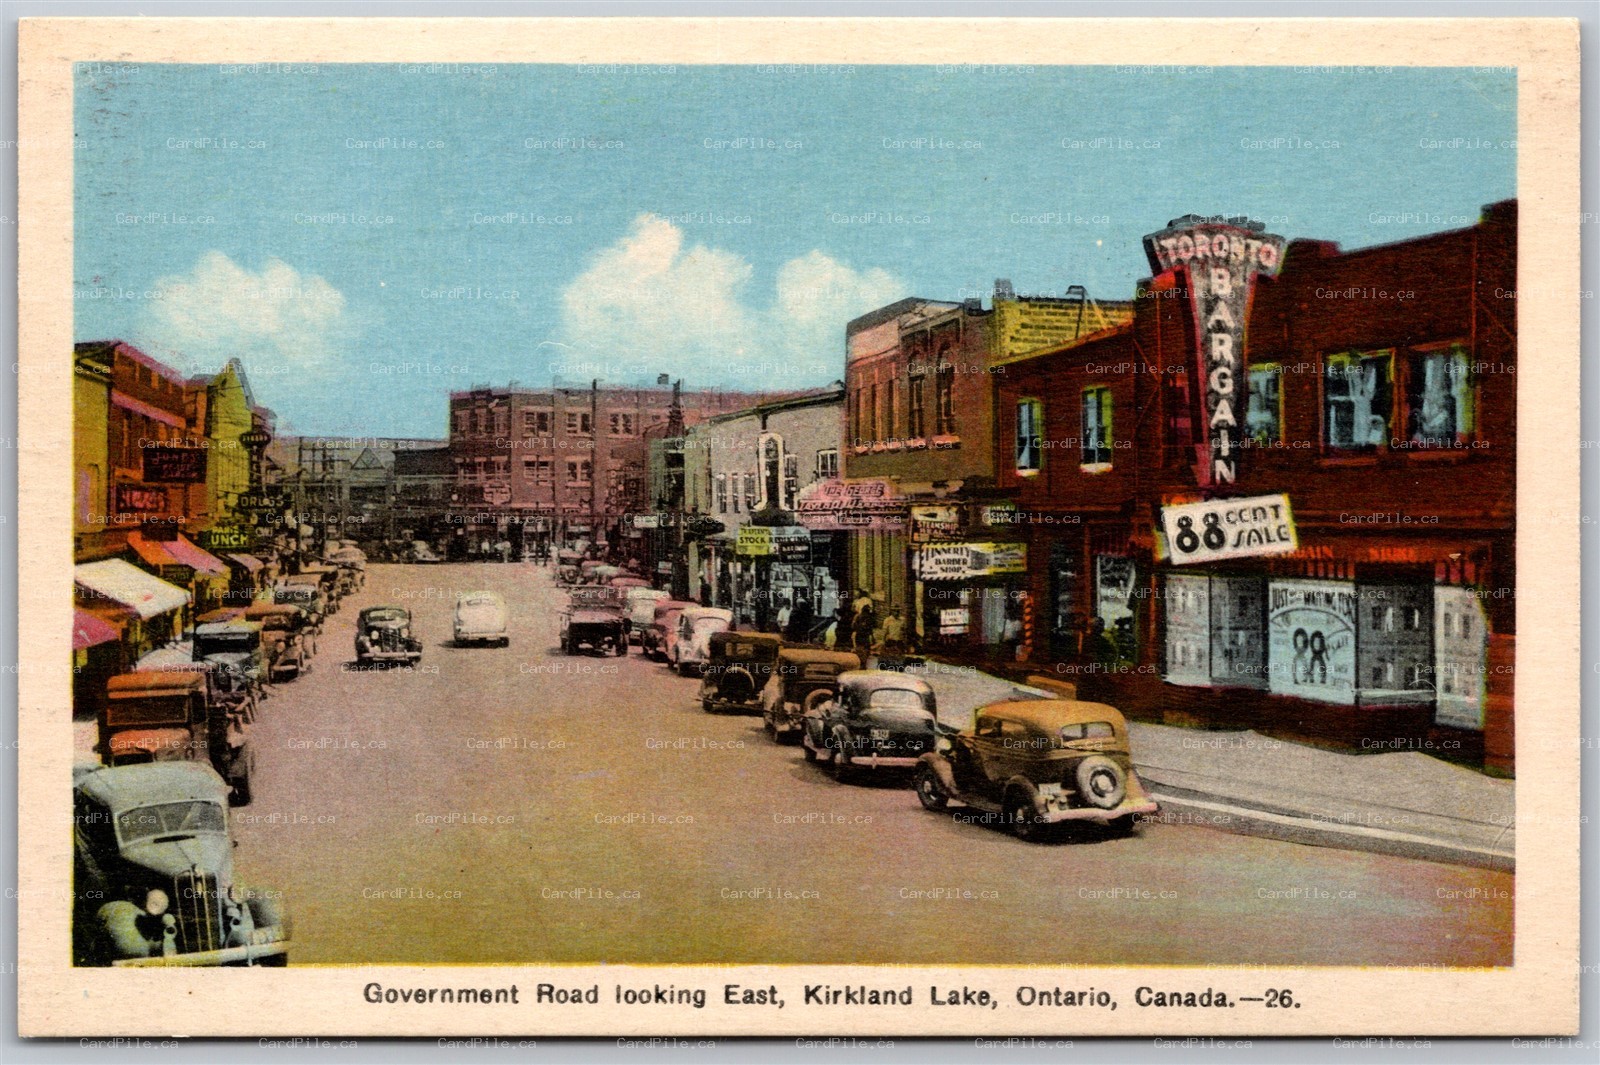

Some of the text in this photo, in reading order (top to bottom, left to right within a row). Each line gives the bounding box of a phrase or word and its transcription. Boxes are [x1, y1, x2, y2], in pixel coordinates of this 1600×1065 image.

[1158, 234, 1279, 267] TORONTO
[1210, 269, 1237, 484] BARGAIN
[240, 496, 284, 507] DRUGS
[739, 536, 766, 544] STOCK
[1176, 503, 1281, 553] 88 CENT
[1232, 524, 1290, 548] SALE
[935, 558, 968, 566] BARBER
